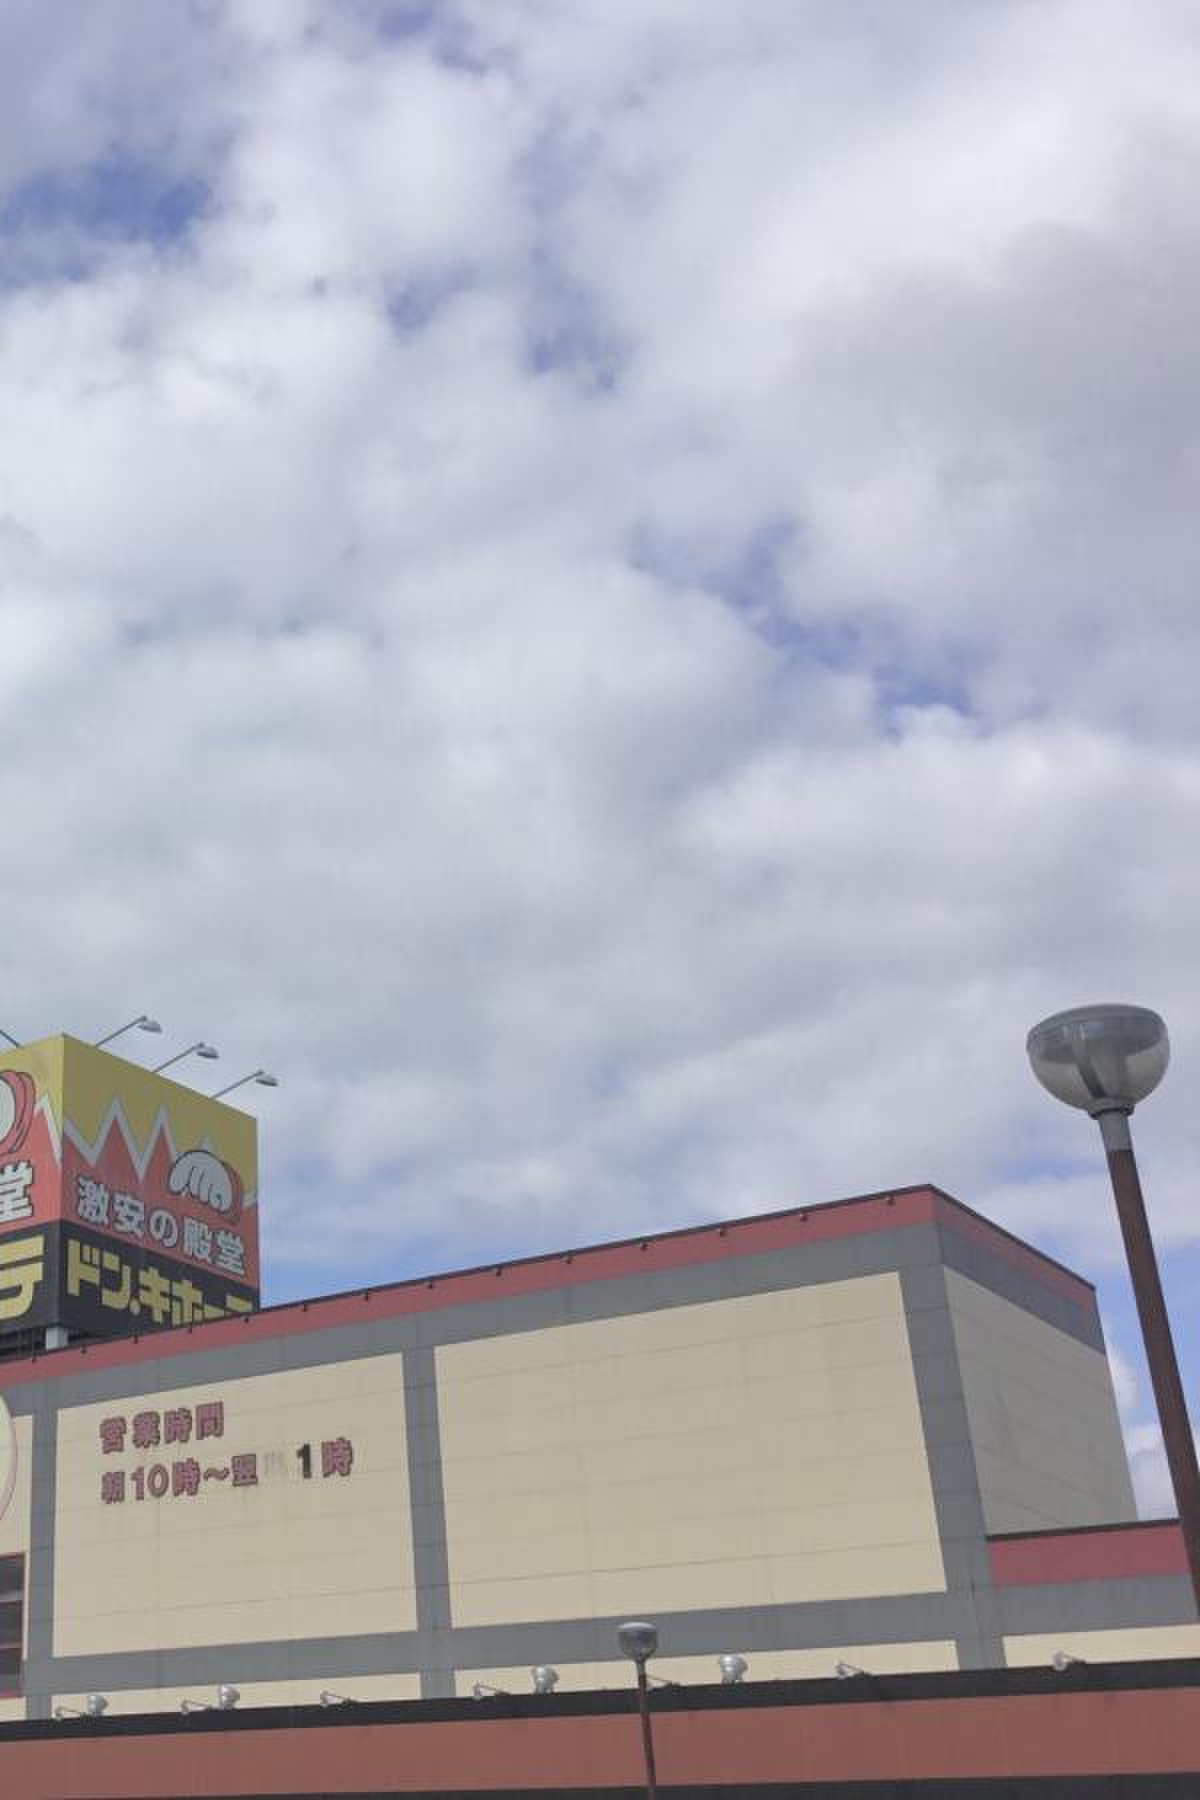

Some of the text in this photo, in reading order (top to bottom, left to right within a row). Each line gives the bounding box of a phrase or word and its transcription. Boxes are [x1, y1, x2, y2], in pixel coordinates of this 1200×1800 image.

[76, 1174, 247, 1278] 激安の殿堂
[99, 1401, 224, 1455] 営業時間
